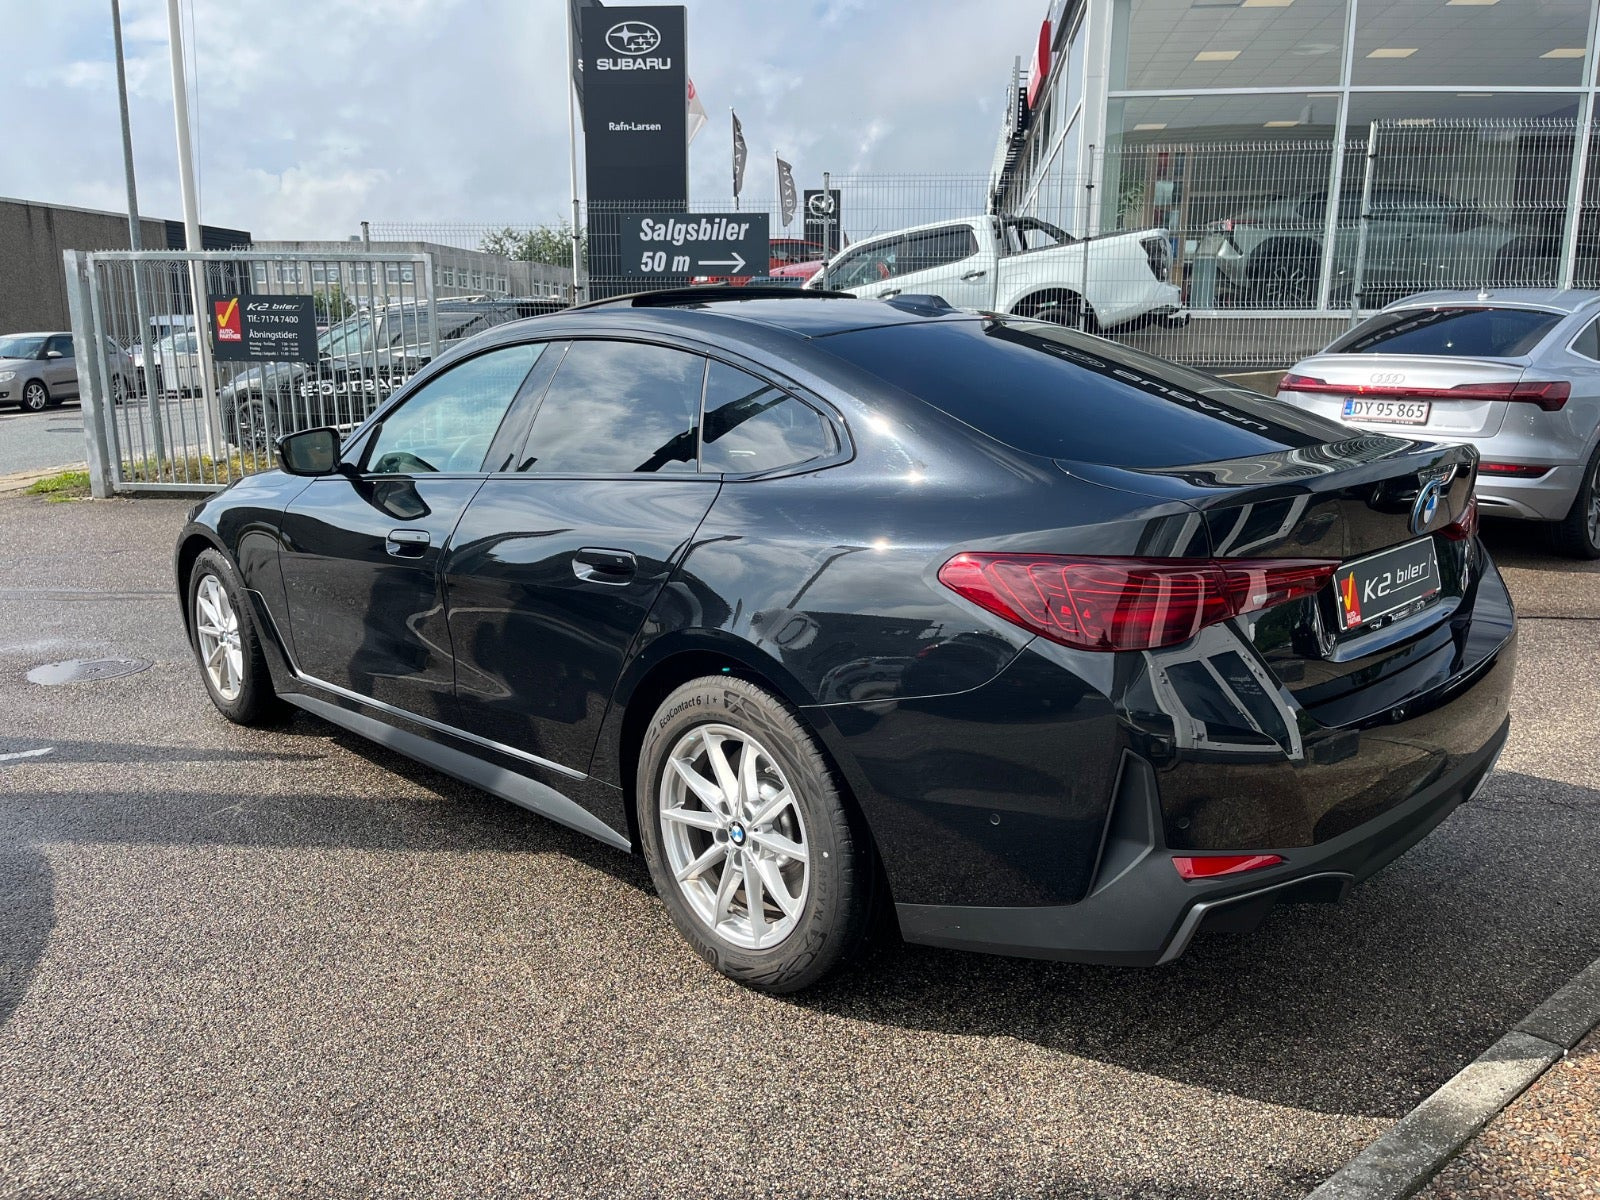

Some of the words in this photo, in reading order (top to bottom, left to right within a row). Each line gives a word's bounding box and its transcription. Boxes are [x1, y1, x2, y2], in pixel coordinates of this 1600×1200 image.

[596, 58, 671, 70] SUBARU
[608, 121, 661, 131] Rafn-Larsen
[639, 217, 750, 246] Salgsbiler
[640, 251, 667, 272] 50
[671, 255, 691, 272] m
[246, 303, 270, 311] K2
[261, 315, 279, 323] 7174
[280, 315, 299, 324] 7400
[248, 328, 298, 340] Åbningstider:
[1354, 401, 1374, 414] DY
[1376, 402, 1393, 416] 95
[1396, 403, 1425, 418] 865
[1363, 572, 1392, 603] K2
[659, 697, 696, 729] EcoContact
